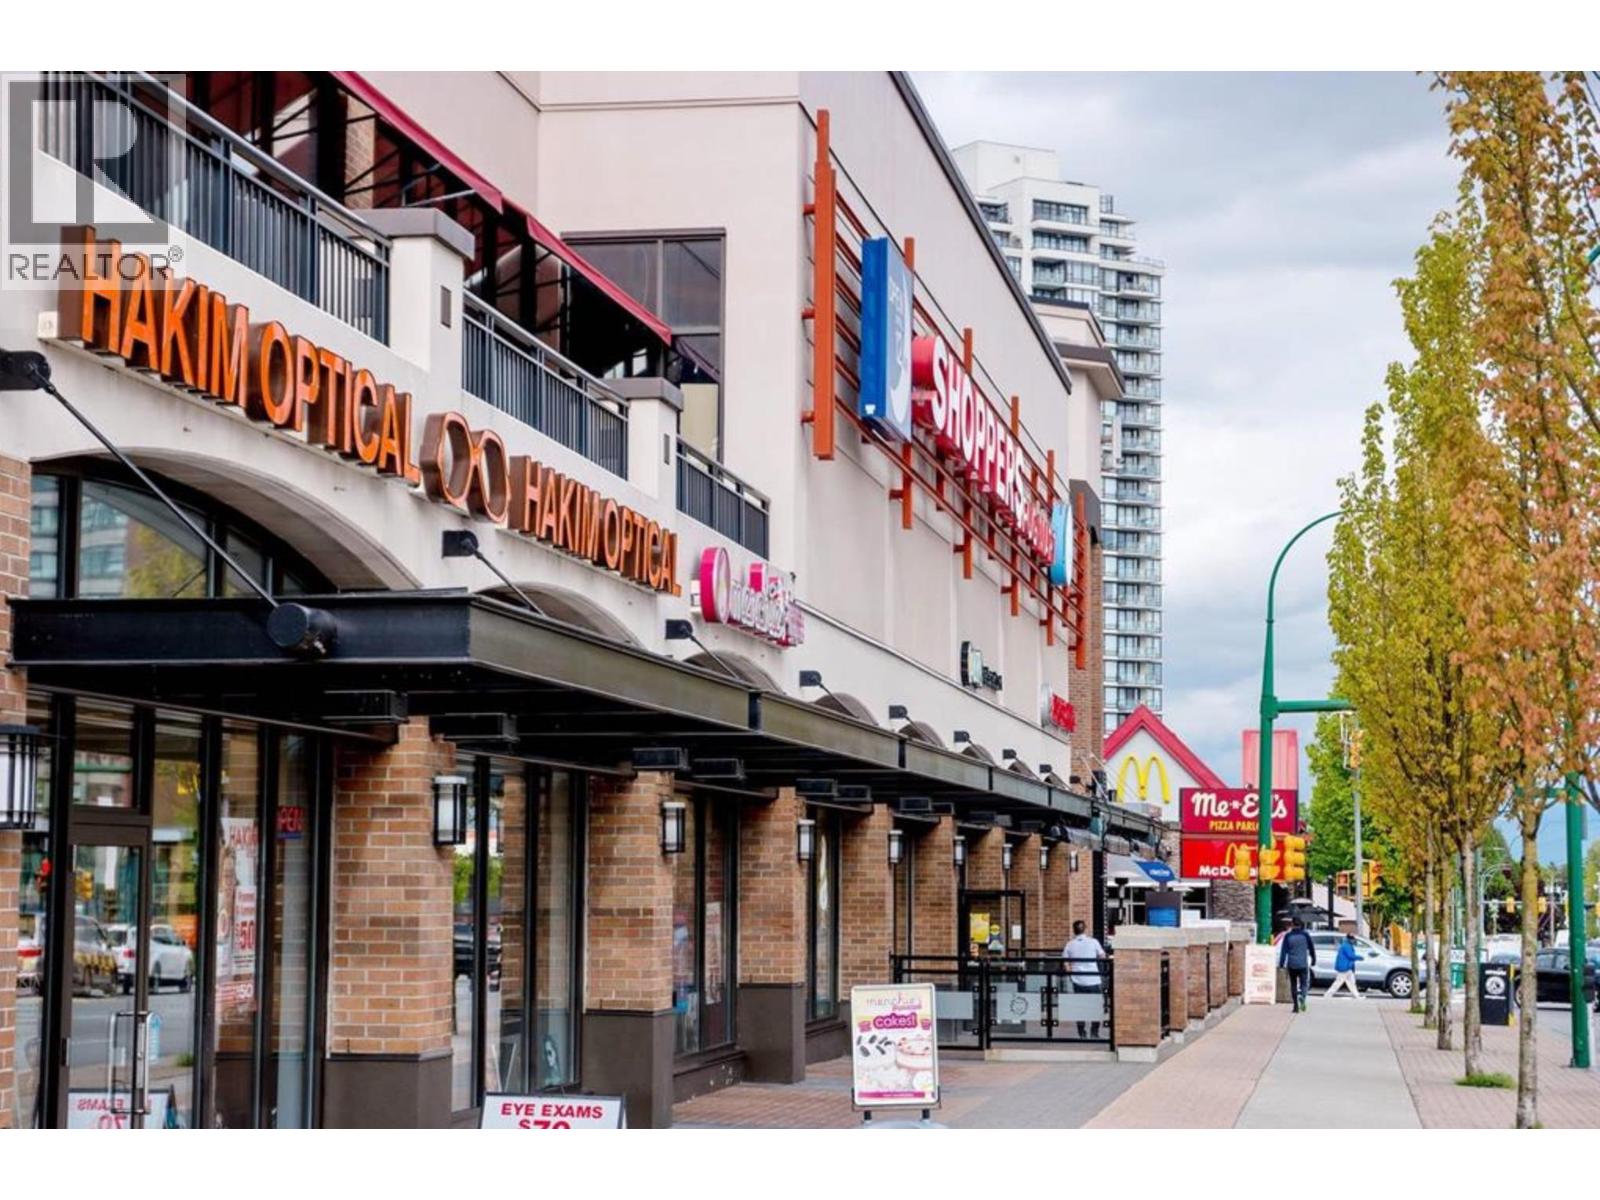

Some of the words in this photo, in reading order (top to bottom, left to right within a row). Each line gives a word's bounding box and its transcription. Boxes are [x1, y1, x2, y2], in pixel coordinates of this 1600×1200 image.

[78, 225, 249, 408] HAKIM
[259, 320, 421, 487] OPTICAL
[931, 334, 1024, 529] SHOPPERS
[522, 456, 601, 563] HAKIM
[603, 498, 682, 598] OPTICAL
[1208, 820, 1234, 831] PIZZA
[501, 1102, 536, 1117] EYE
[540, 1103, 604, 1120] EXAMS
